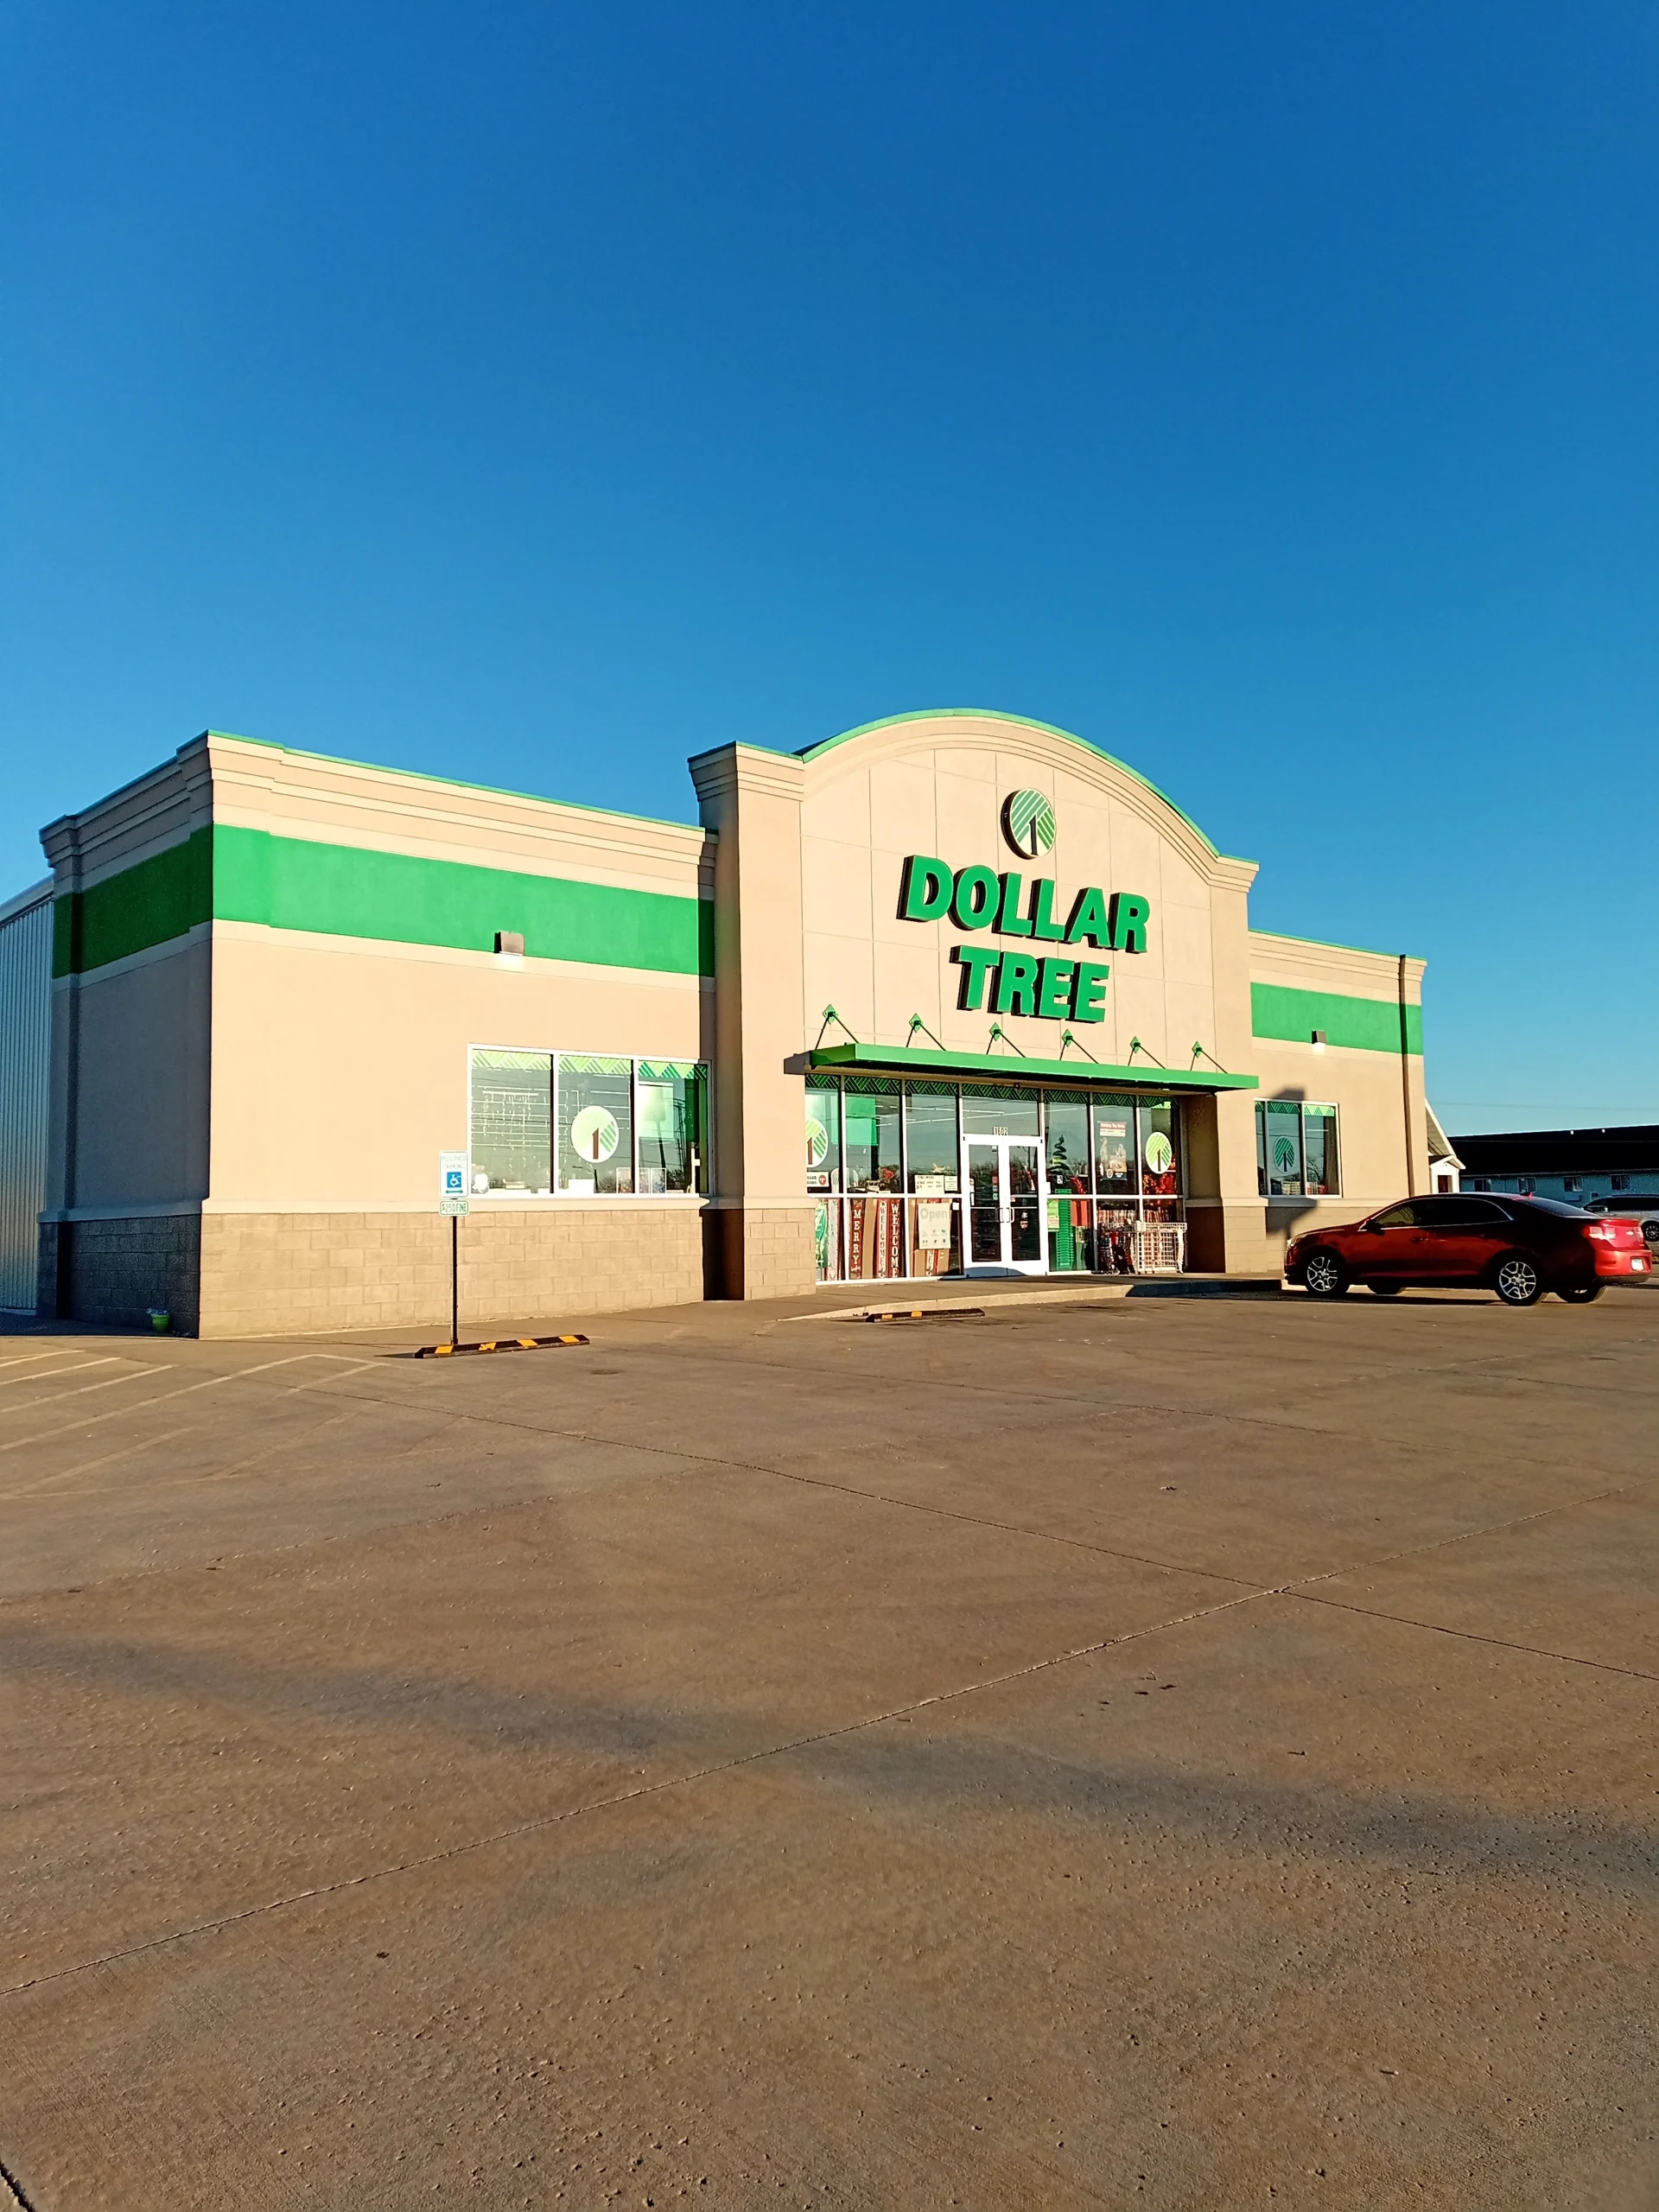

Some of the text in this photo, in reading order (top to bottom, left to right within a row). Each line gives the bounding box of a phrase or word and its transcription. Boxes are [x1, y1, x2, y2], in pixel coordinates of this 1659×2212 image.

[896, 855, 1150, 954] DOLLAR
[949, 945, 1109, 1024] TREE
[853, 1210, 862, 1264] MERRY
[891, 1204, 899, 1277] WELCOME
[920, 1207, 948, 1222] Open
